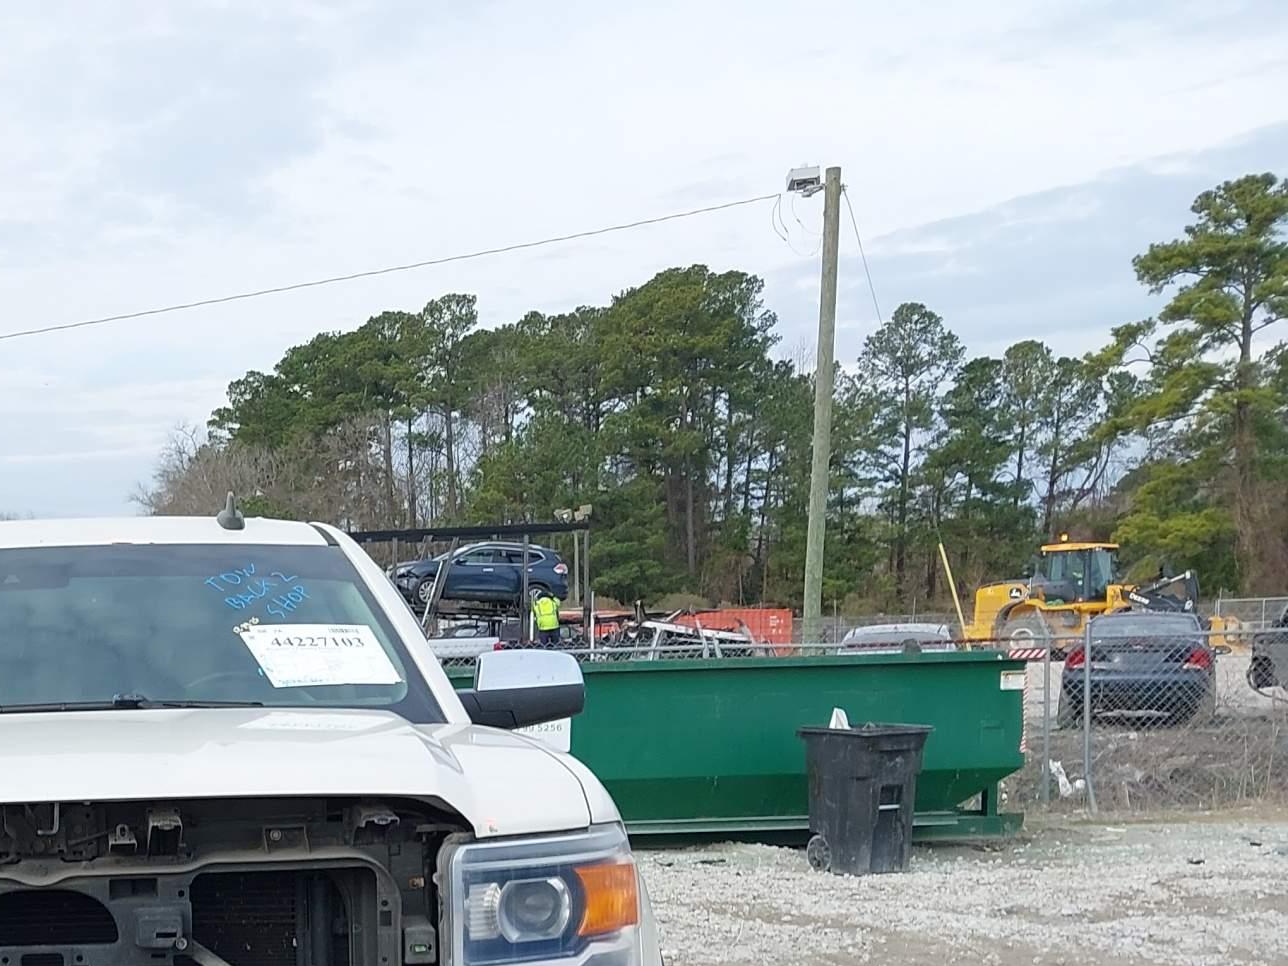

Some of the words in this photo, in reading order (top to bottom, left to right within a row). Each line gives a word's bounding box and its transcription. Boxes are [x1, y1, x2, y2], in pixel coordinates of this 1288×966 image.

[204, 562, 255, 592] TOW
[224, 579, 278, 609] BACK
[271, 571, 298, 582] 2
[267, 585, 312, 618] SHOP
[271, 636, 365, 648] 44227103
